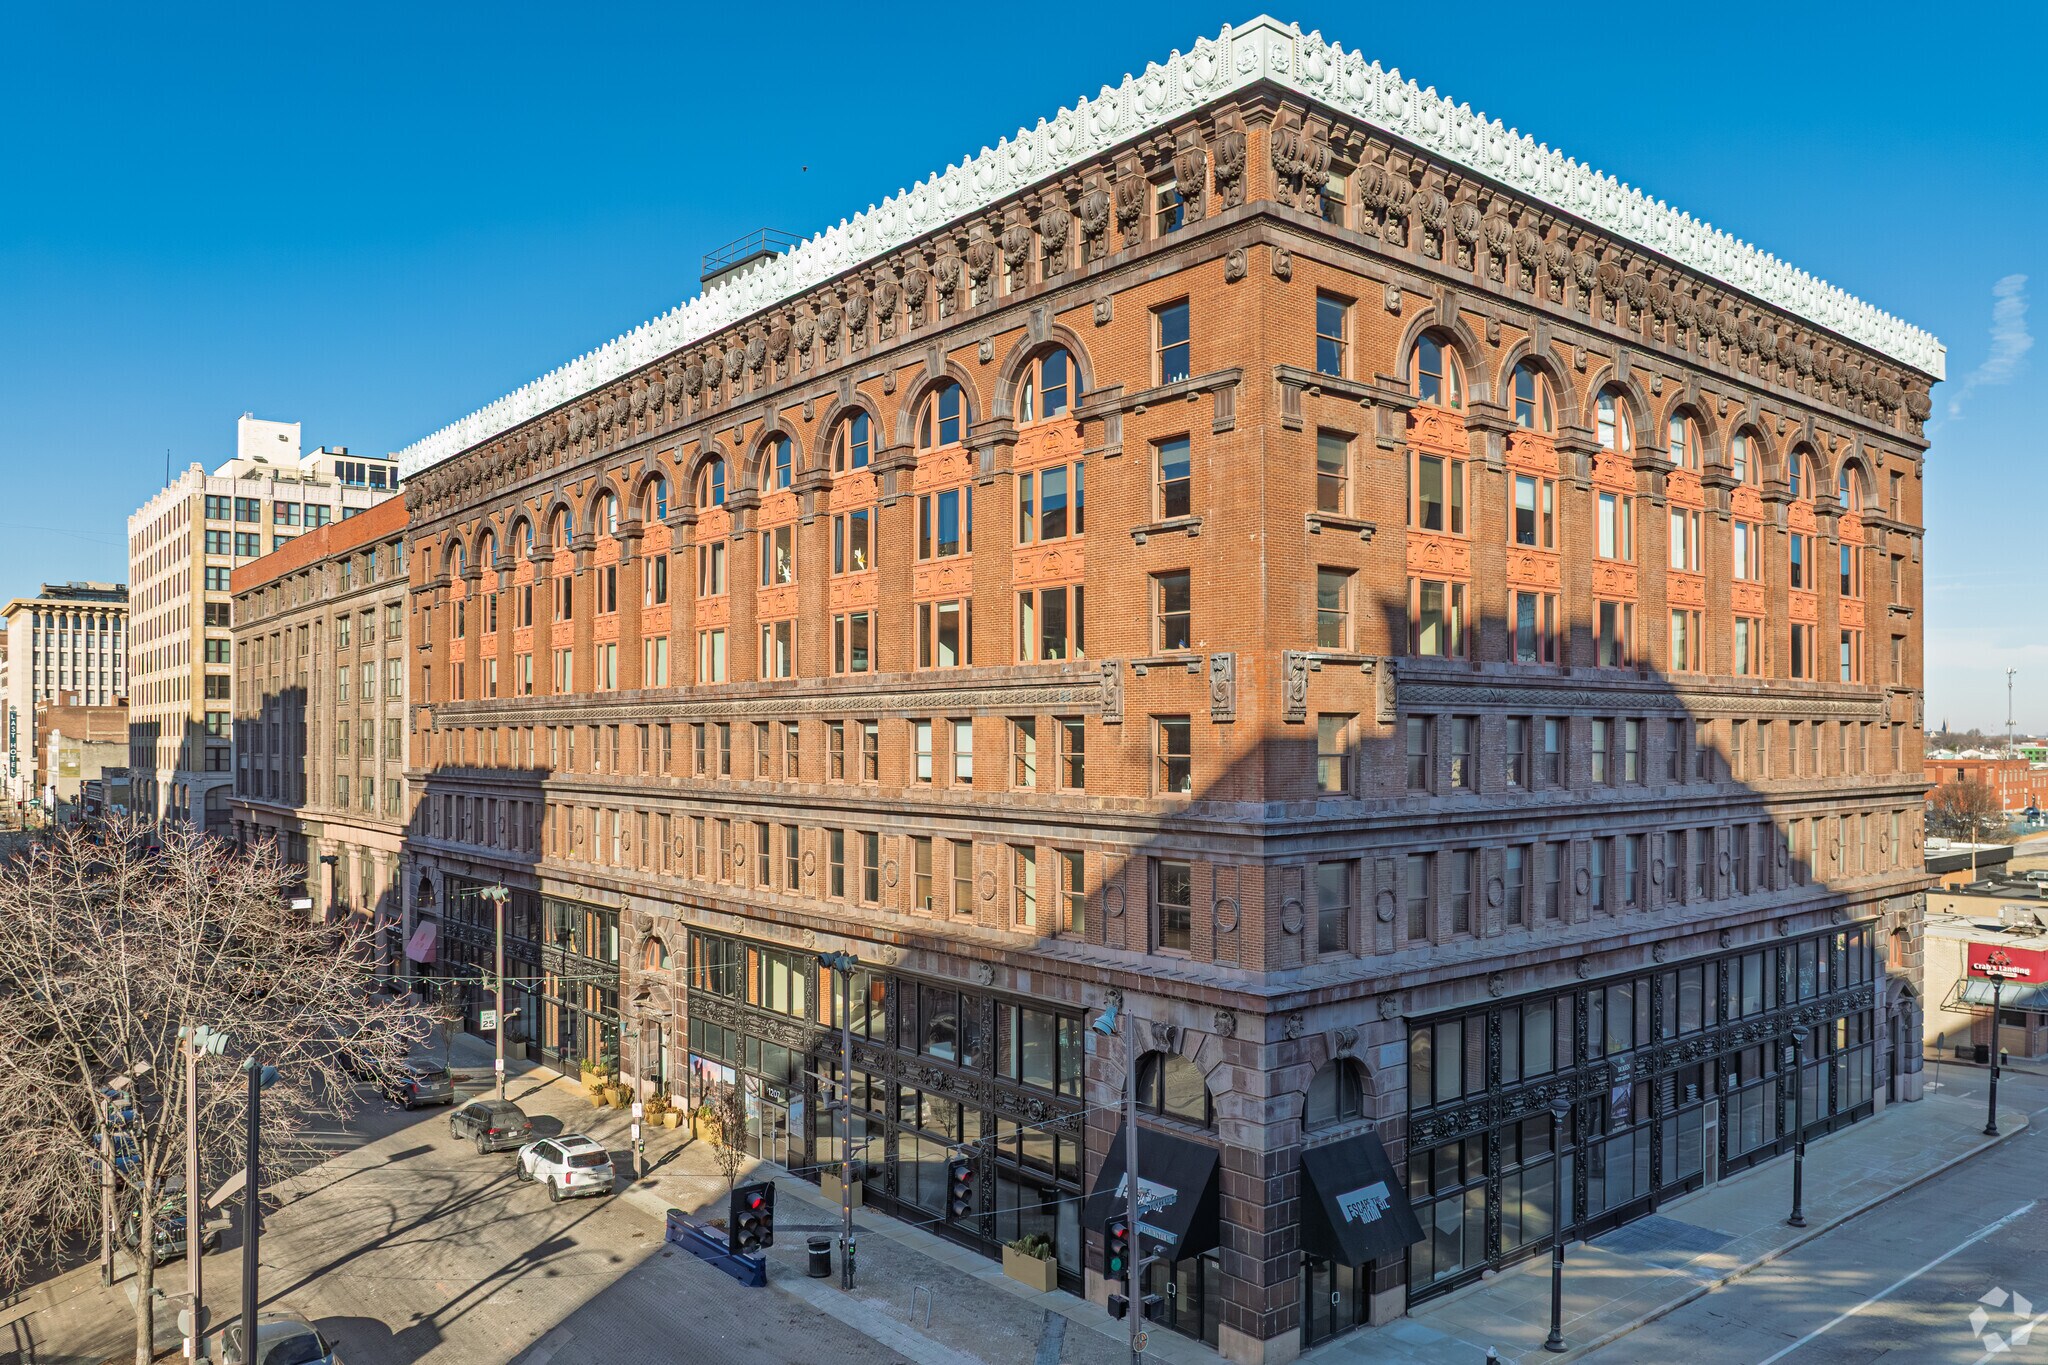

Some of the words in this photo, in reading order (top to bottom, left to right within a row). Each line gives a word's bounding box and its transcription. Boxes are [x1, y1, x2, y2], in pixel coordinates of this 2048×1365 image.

[1973, 963, 1997, 971] Crab's
[1998, 965, 2031, 976] Landing
[482, 1020, 495, 1028] 25
[767, 1087, 781, 1099] 1207
[1347, 1198, 1371, 1218] ESCAPE
[1379, 1199, 1391, 1211] STL
